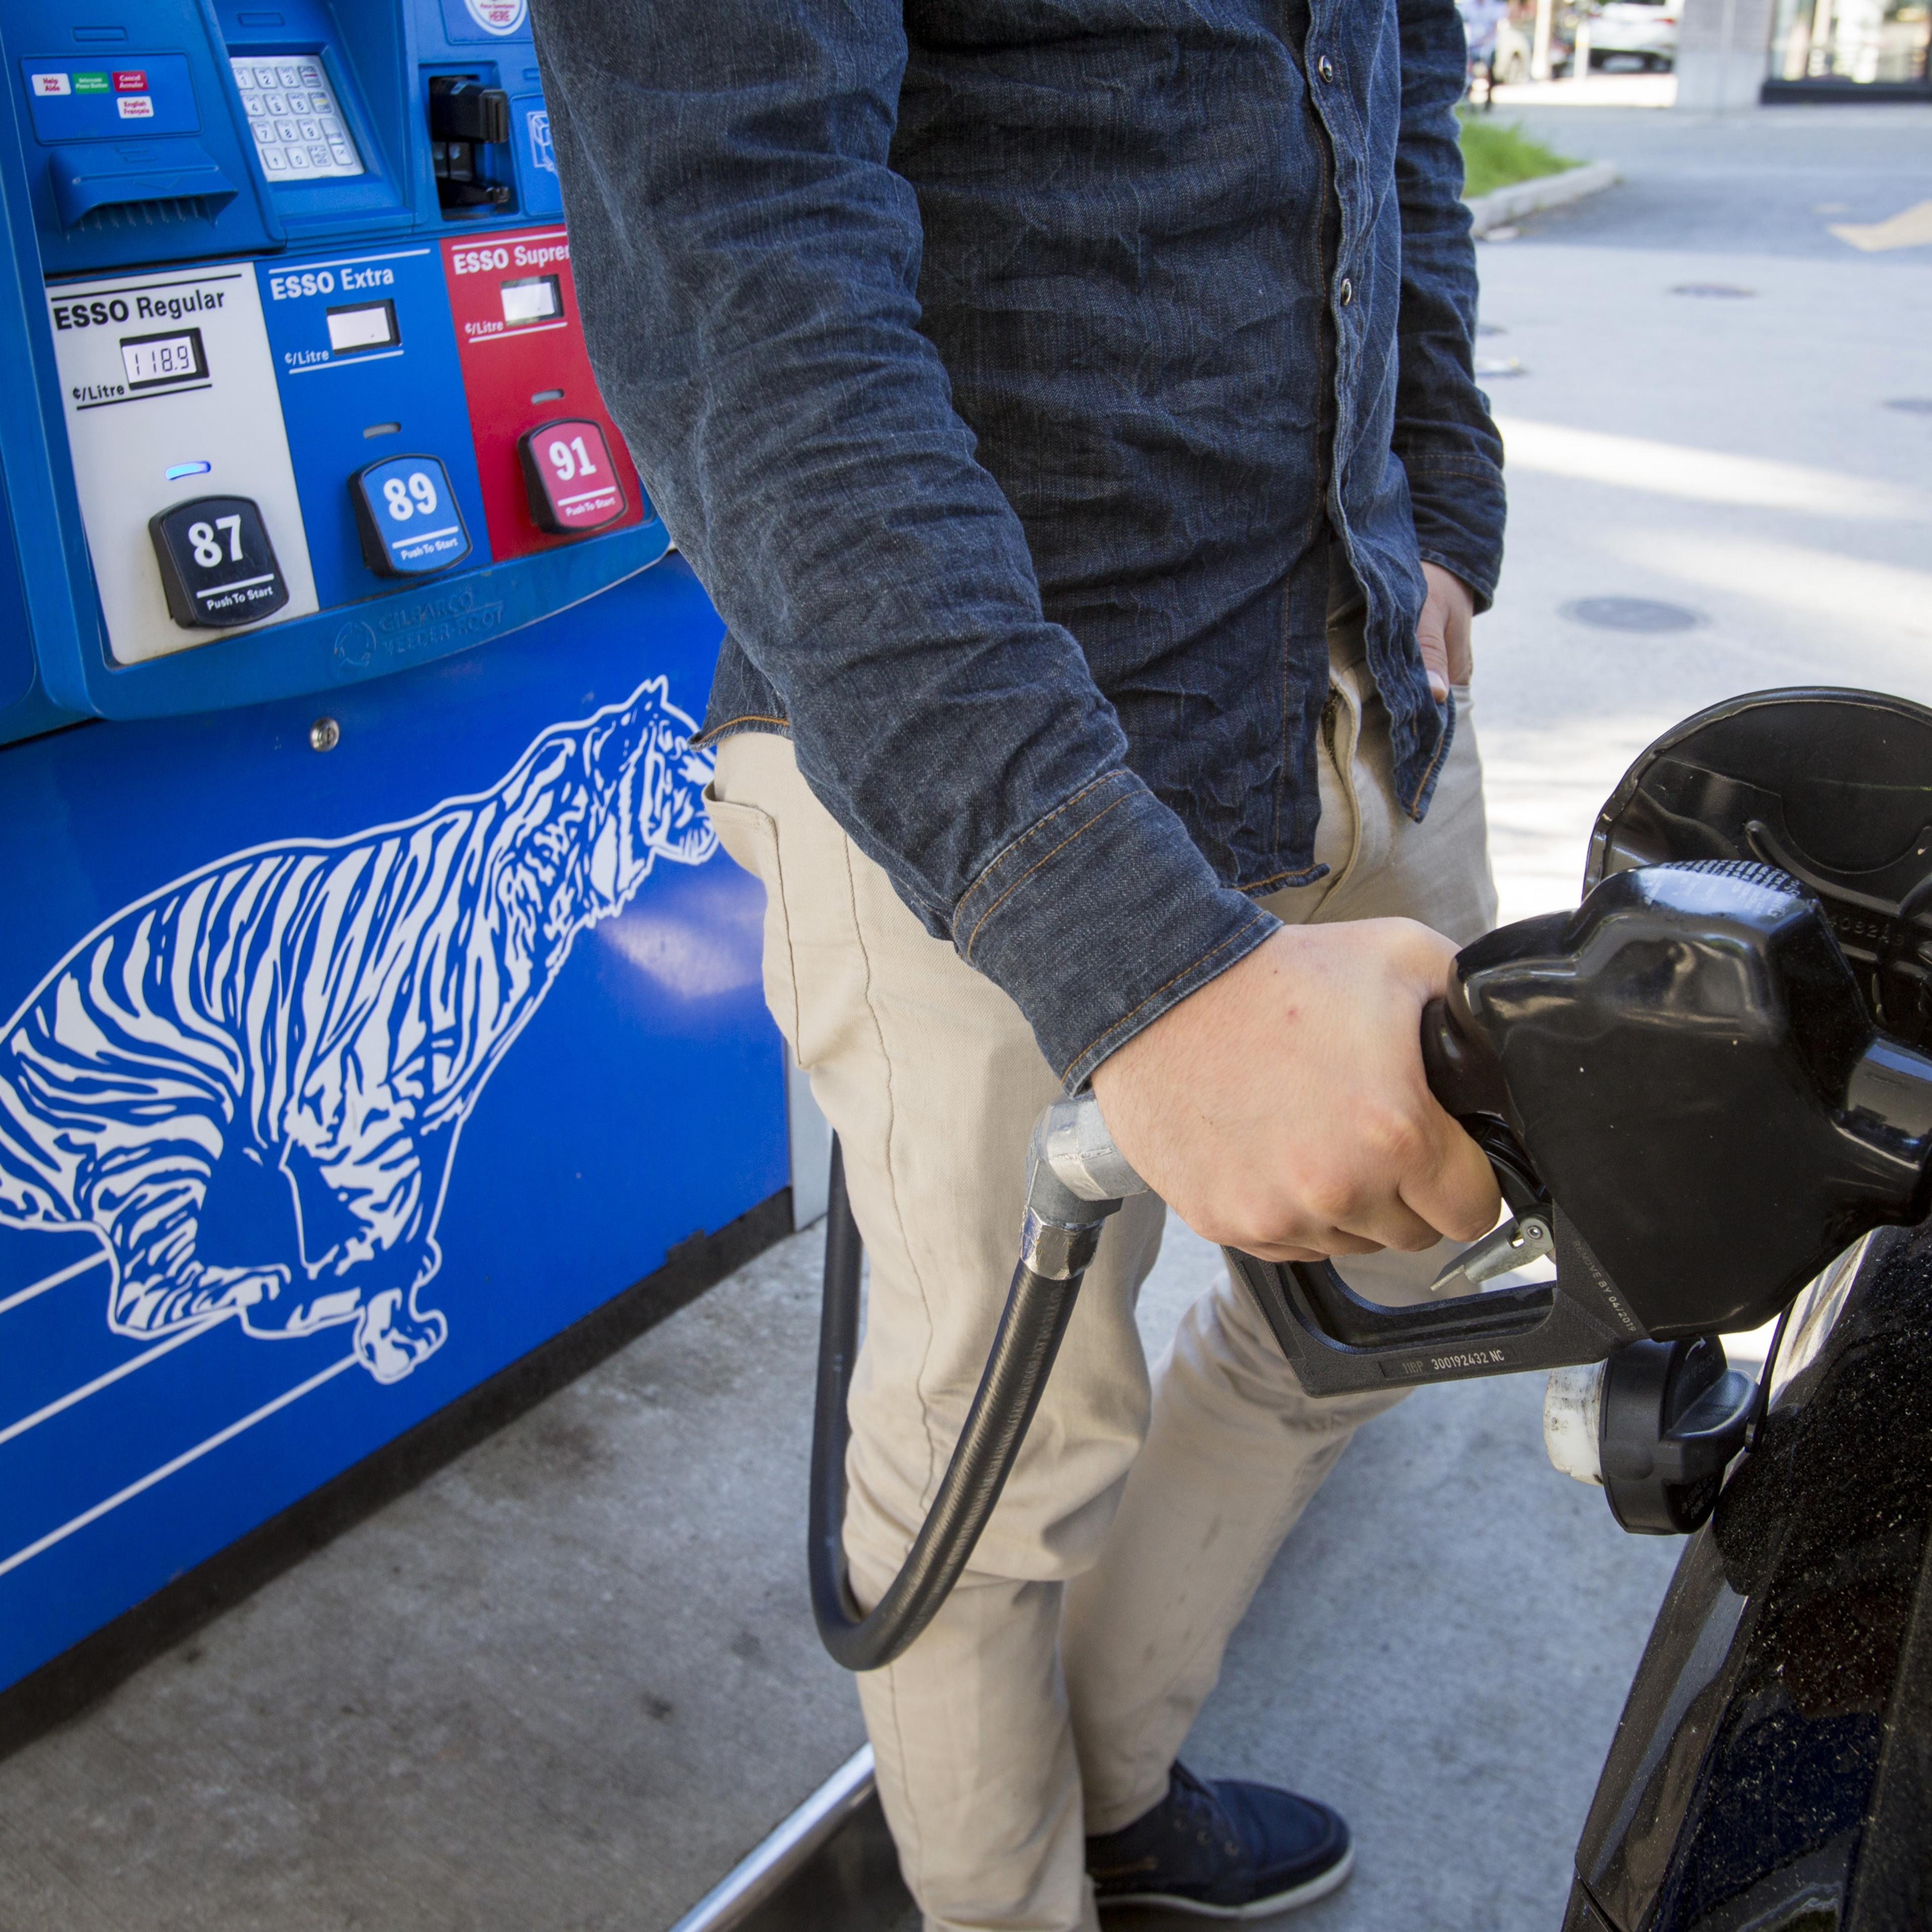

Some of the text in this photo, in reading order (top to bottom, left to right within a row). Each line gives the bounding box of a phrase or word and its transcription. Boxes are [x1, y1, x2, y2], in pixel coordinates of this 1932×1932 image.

[453, 248, 509, 275] ESSO
[270, 267, 394, 301] ESSO Extra
[53, 289, 225, 331] ESSO Regular
[134, 345, 190, 376] 118.9
[284, 350, 330, 366] ¢/Litre
[72, 383, 125, 400] ¢/Litre
[549, 436, 597, 481] 91
[383, 472, 437, 521] 89
[188, 514, 244, 568] 87
[206, 596, 232, 611] Push
[247, 586, 273, 600] Start
[1598, 1280, 1612, 1293] BY
[1431, 1352, 1489, 1370] 300192432
[1489, 1349, 1505, 1362] NC
